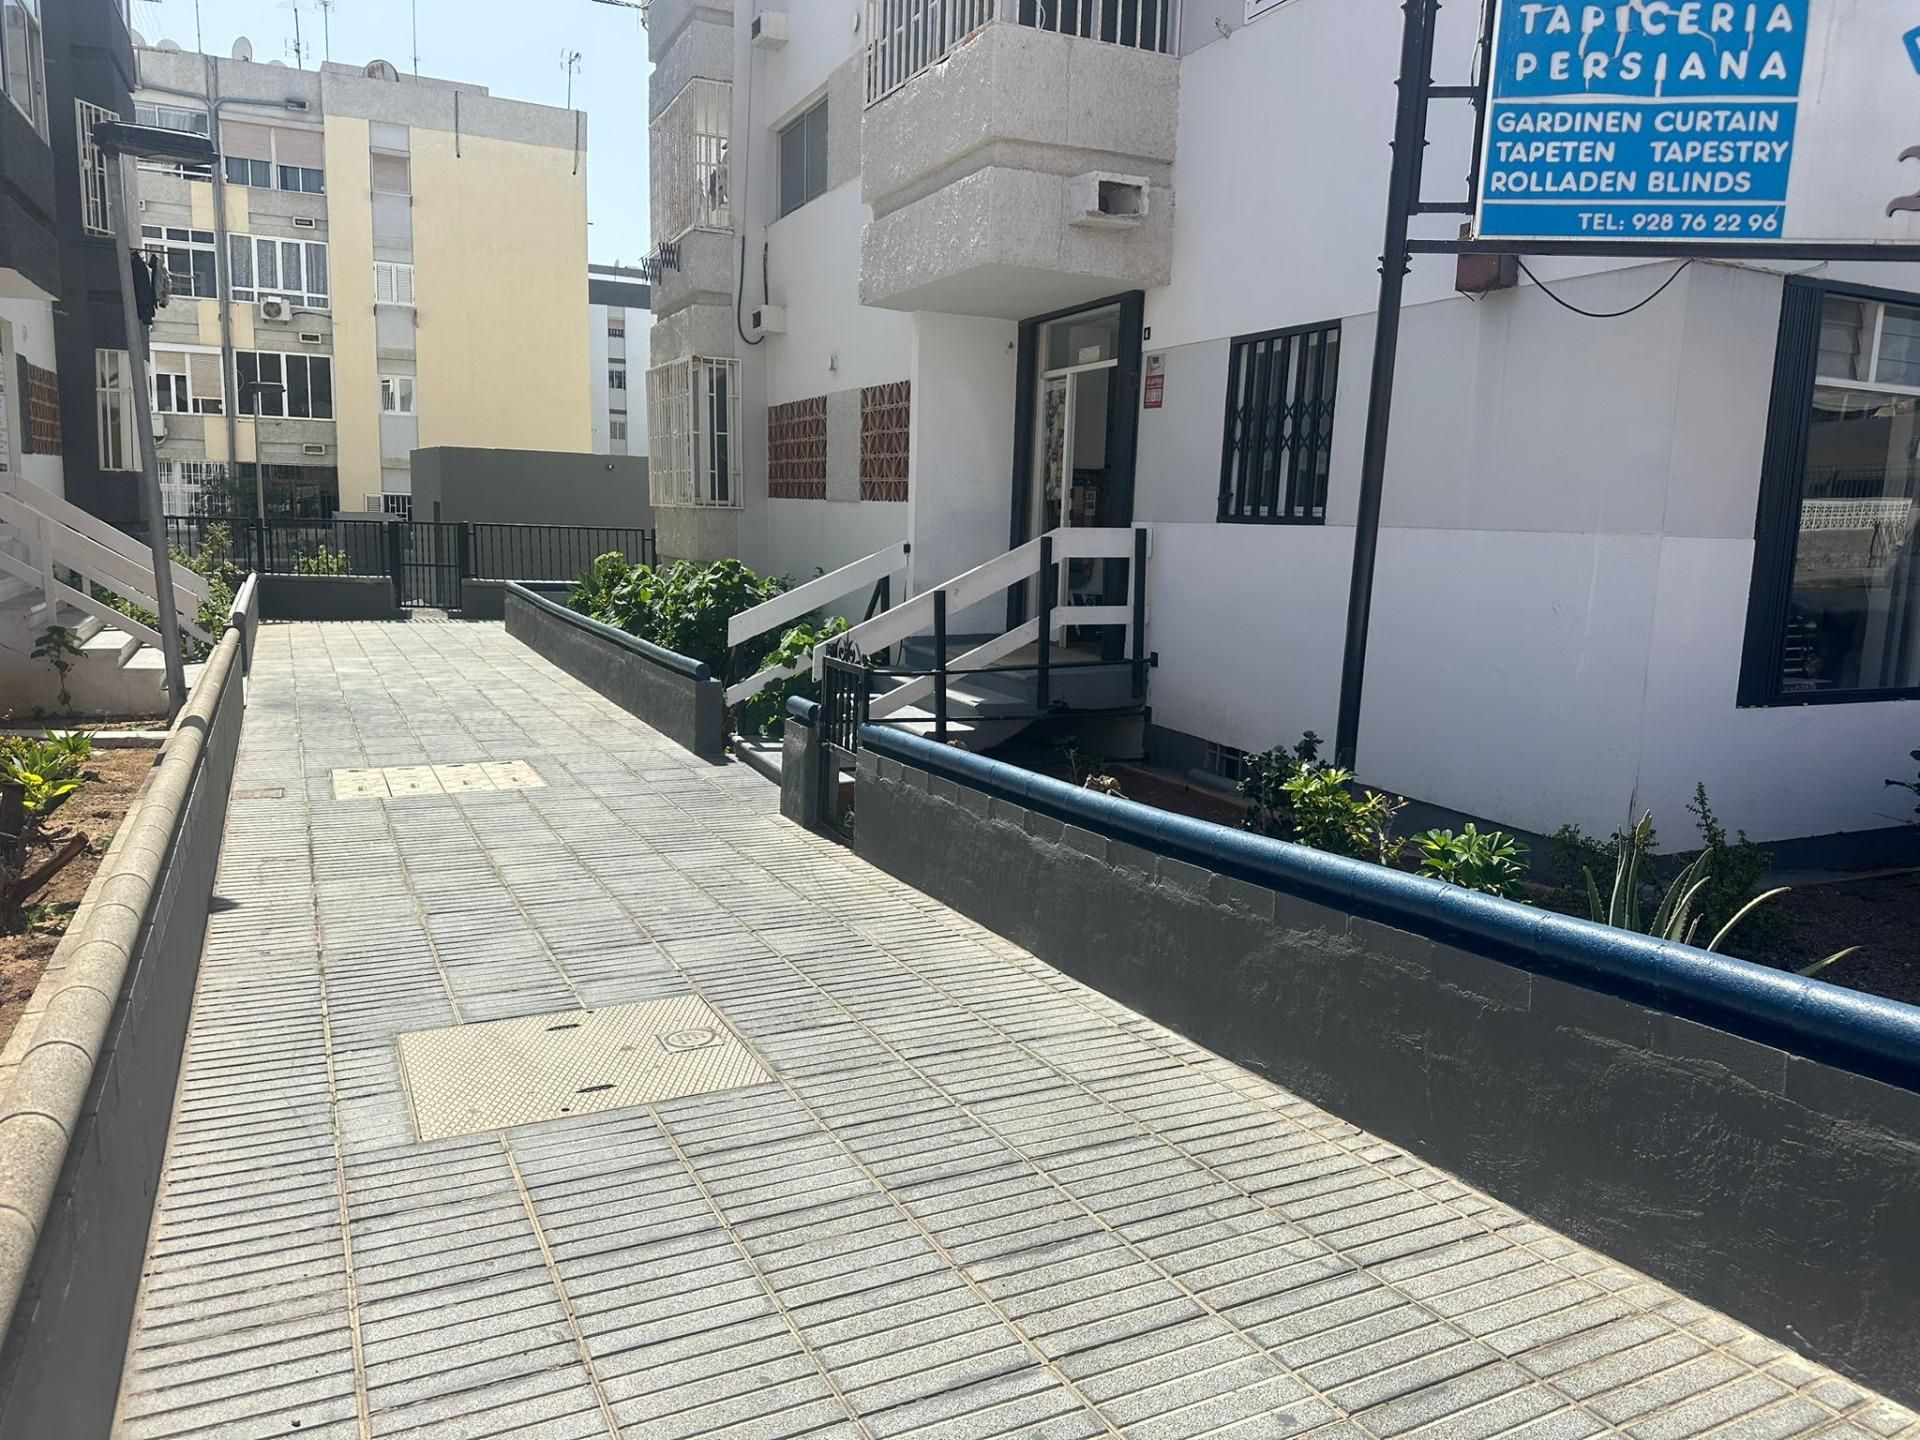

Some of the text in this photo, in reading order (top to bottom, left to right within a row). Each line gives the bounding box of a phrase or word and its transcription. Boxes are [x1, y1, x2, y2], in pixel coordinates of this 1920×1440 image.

[1520, 3, 1793, 35] TAPICERIA
[1515, 51, 1787, 81] PERSIANA
[1497, 110, 1779, 133] GARDINEN CURTAIN
[1496, 141, 1789, 162] TAPETEN TAPESTRY
[1490, 171, 1751, 192] ROLLADEN BLINDS
[1578, 213, 1777, 231] TEL: 928 76 22 96
